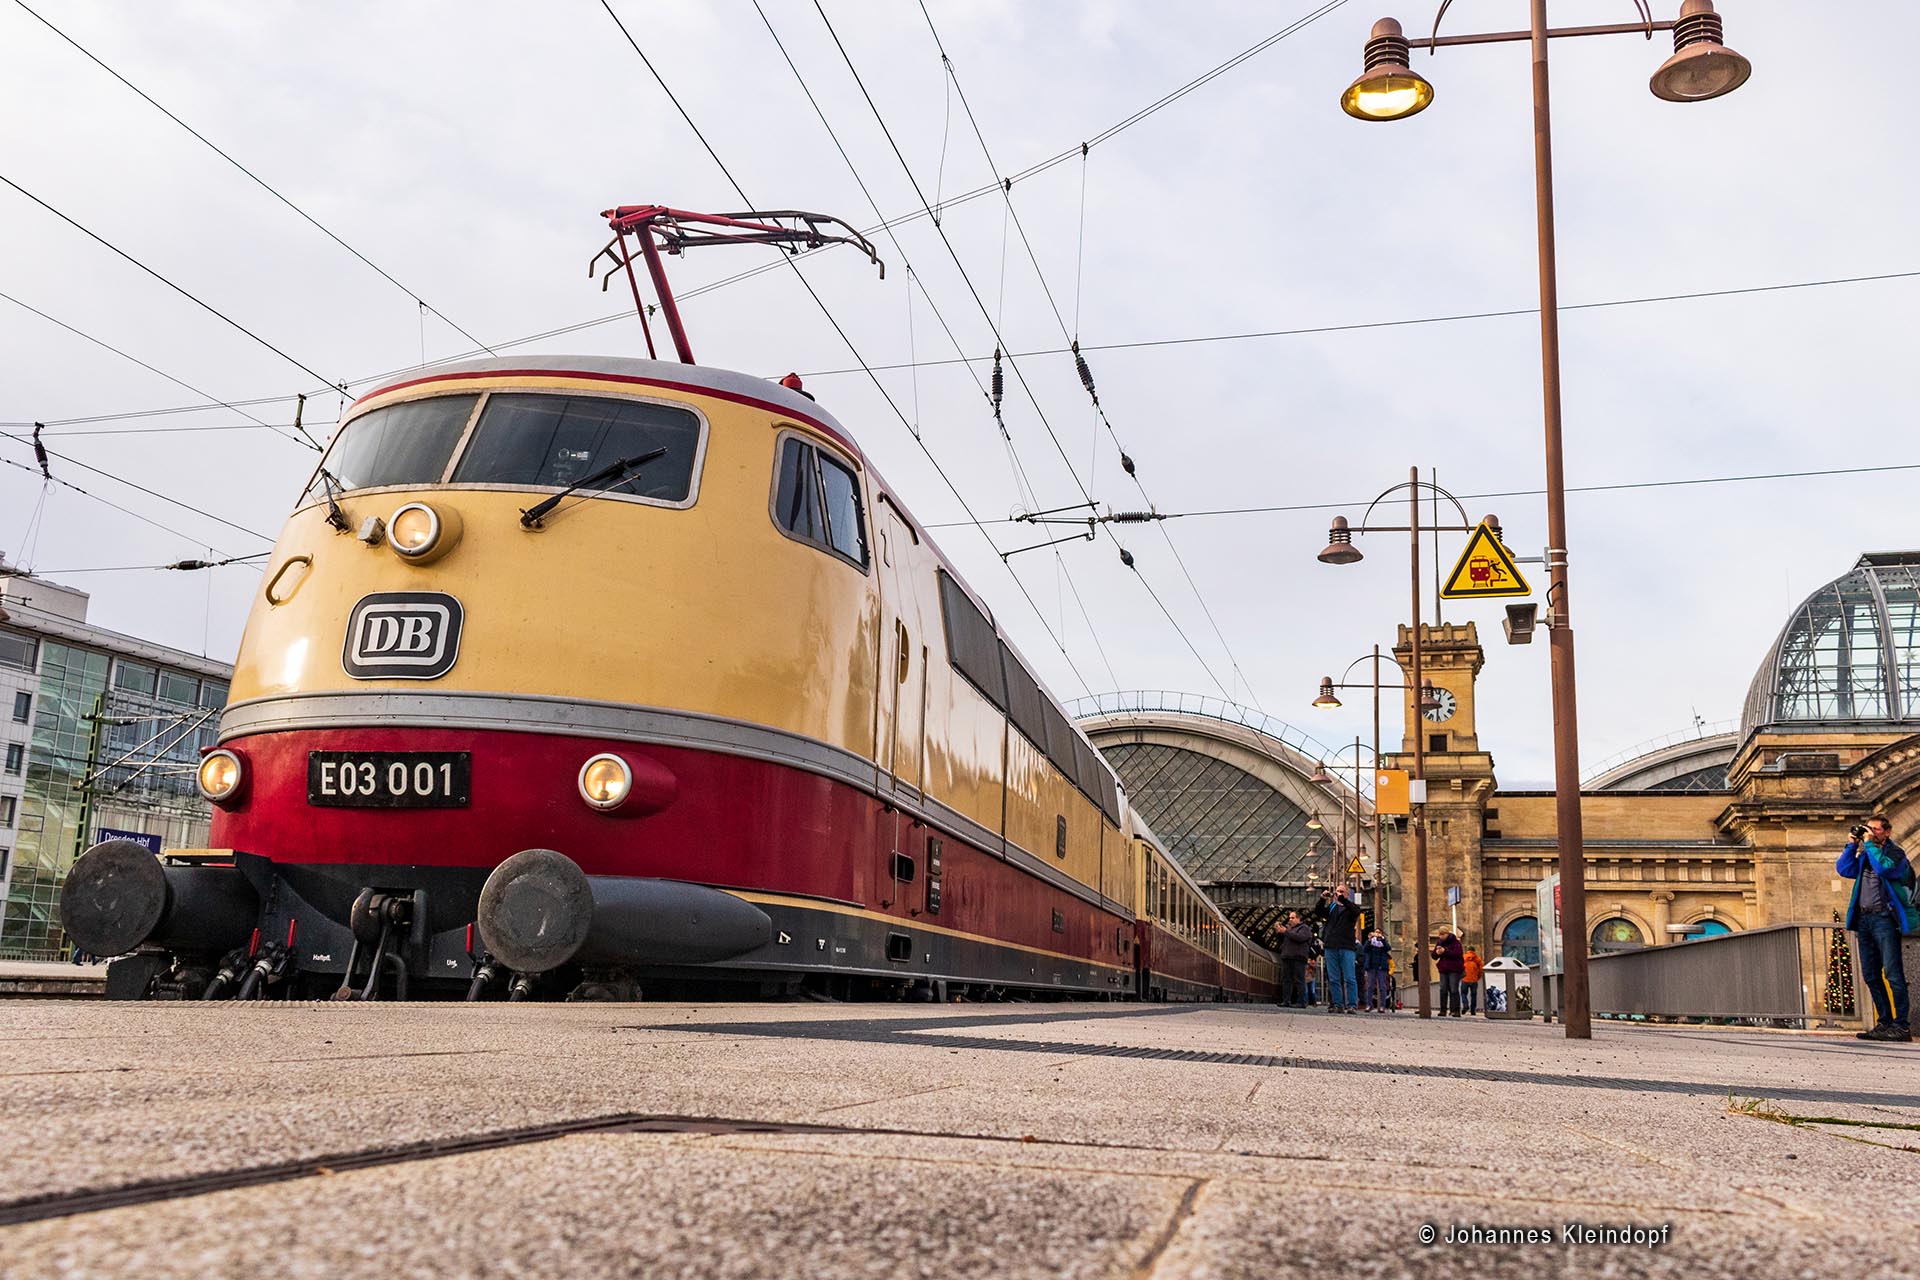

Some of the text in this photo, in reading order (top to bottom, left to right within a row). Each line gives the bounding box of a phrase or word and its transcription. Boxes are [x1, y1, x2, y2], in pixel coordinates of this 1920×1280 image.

[362, 616, 433, 653] DB
[321, 761, 451, 796] E03 001
[136, 836, 150, 848] Hbf
